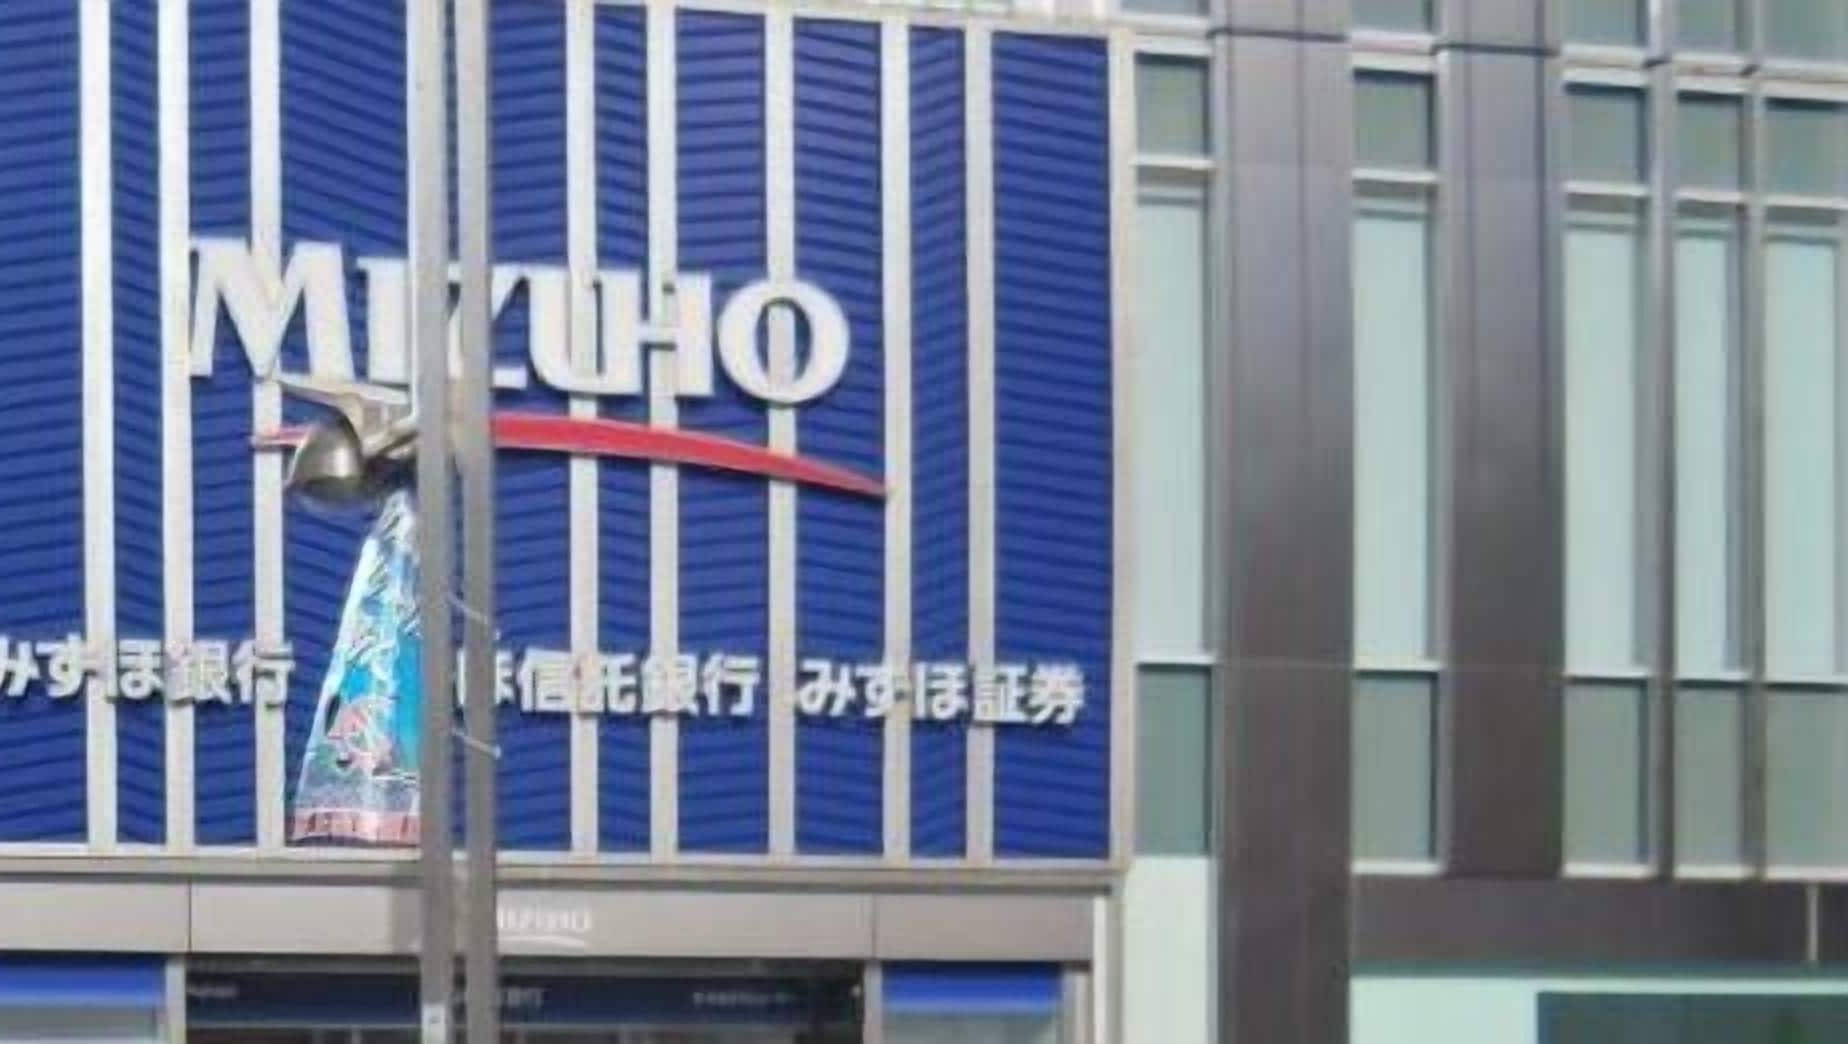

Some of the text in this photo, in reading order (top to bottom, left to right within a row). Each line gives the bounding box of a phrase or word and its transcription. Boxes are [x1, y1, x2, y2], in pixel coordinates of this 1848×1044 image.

[188, 237, 850, 403] MIZUHO
[798, 657, 1085, 725] みずほ証券
